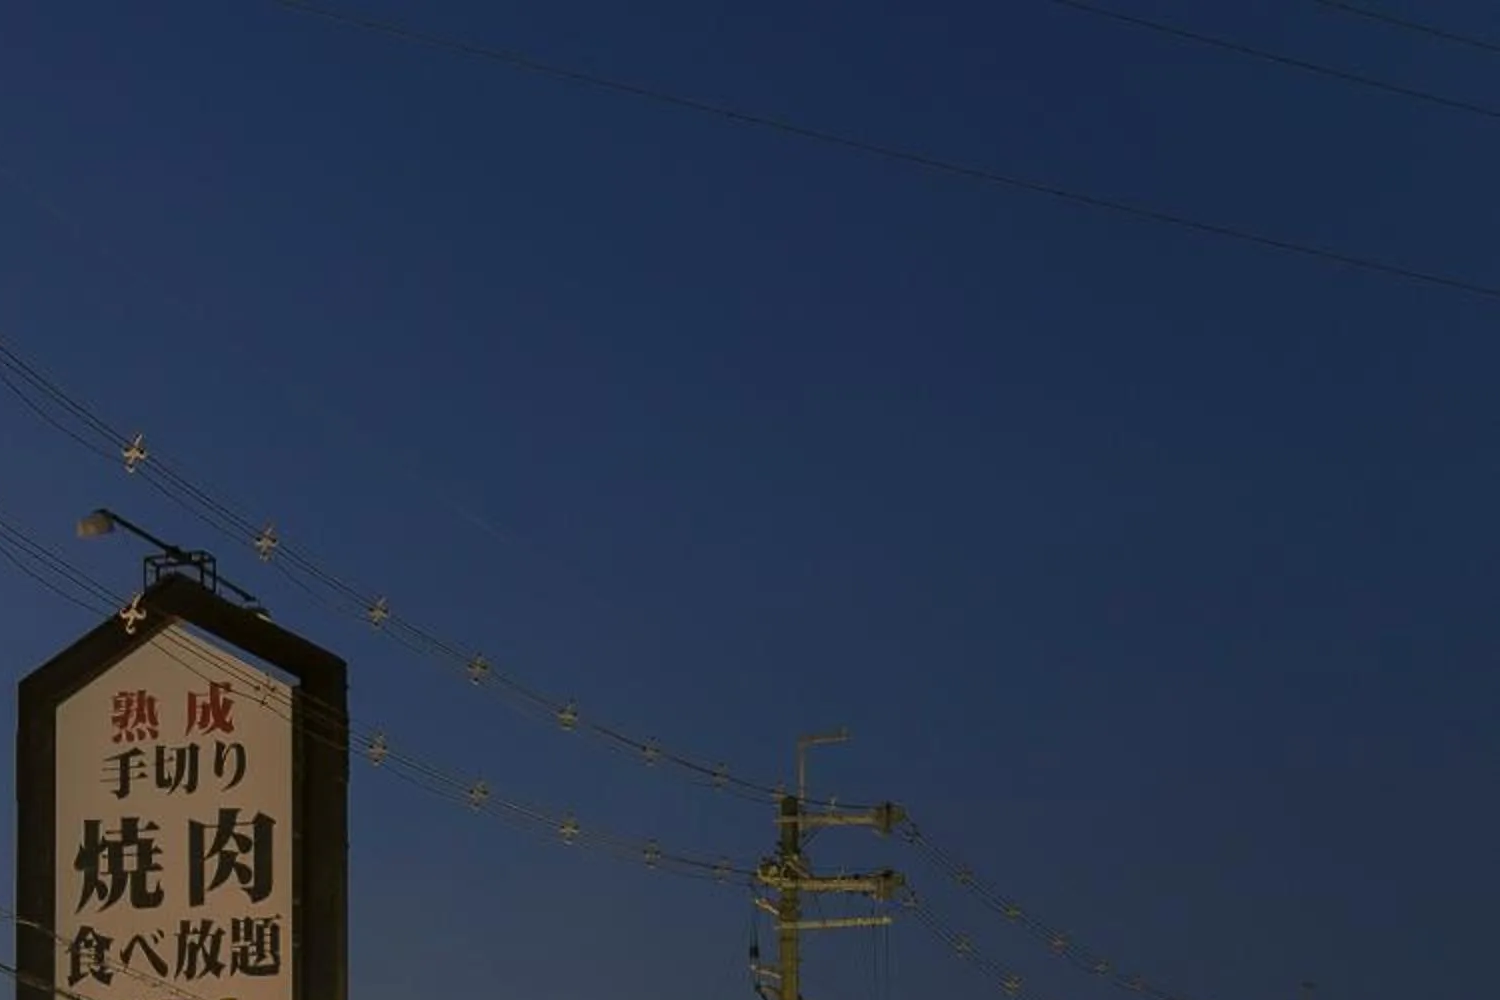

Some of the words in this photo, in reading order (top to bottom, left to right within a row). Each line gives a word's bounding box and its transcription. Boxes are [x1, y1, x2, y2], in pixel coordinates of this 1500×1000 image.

[111, 682, 235, 742] 熟成
[100, 740, 247, 799] 手切り
[74, 808, 277, 913] 焼肉
[67, 913, 283, 987] 食べ放題
